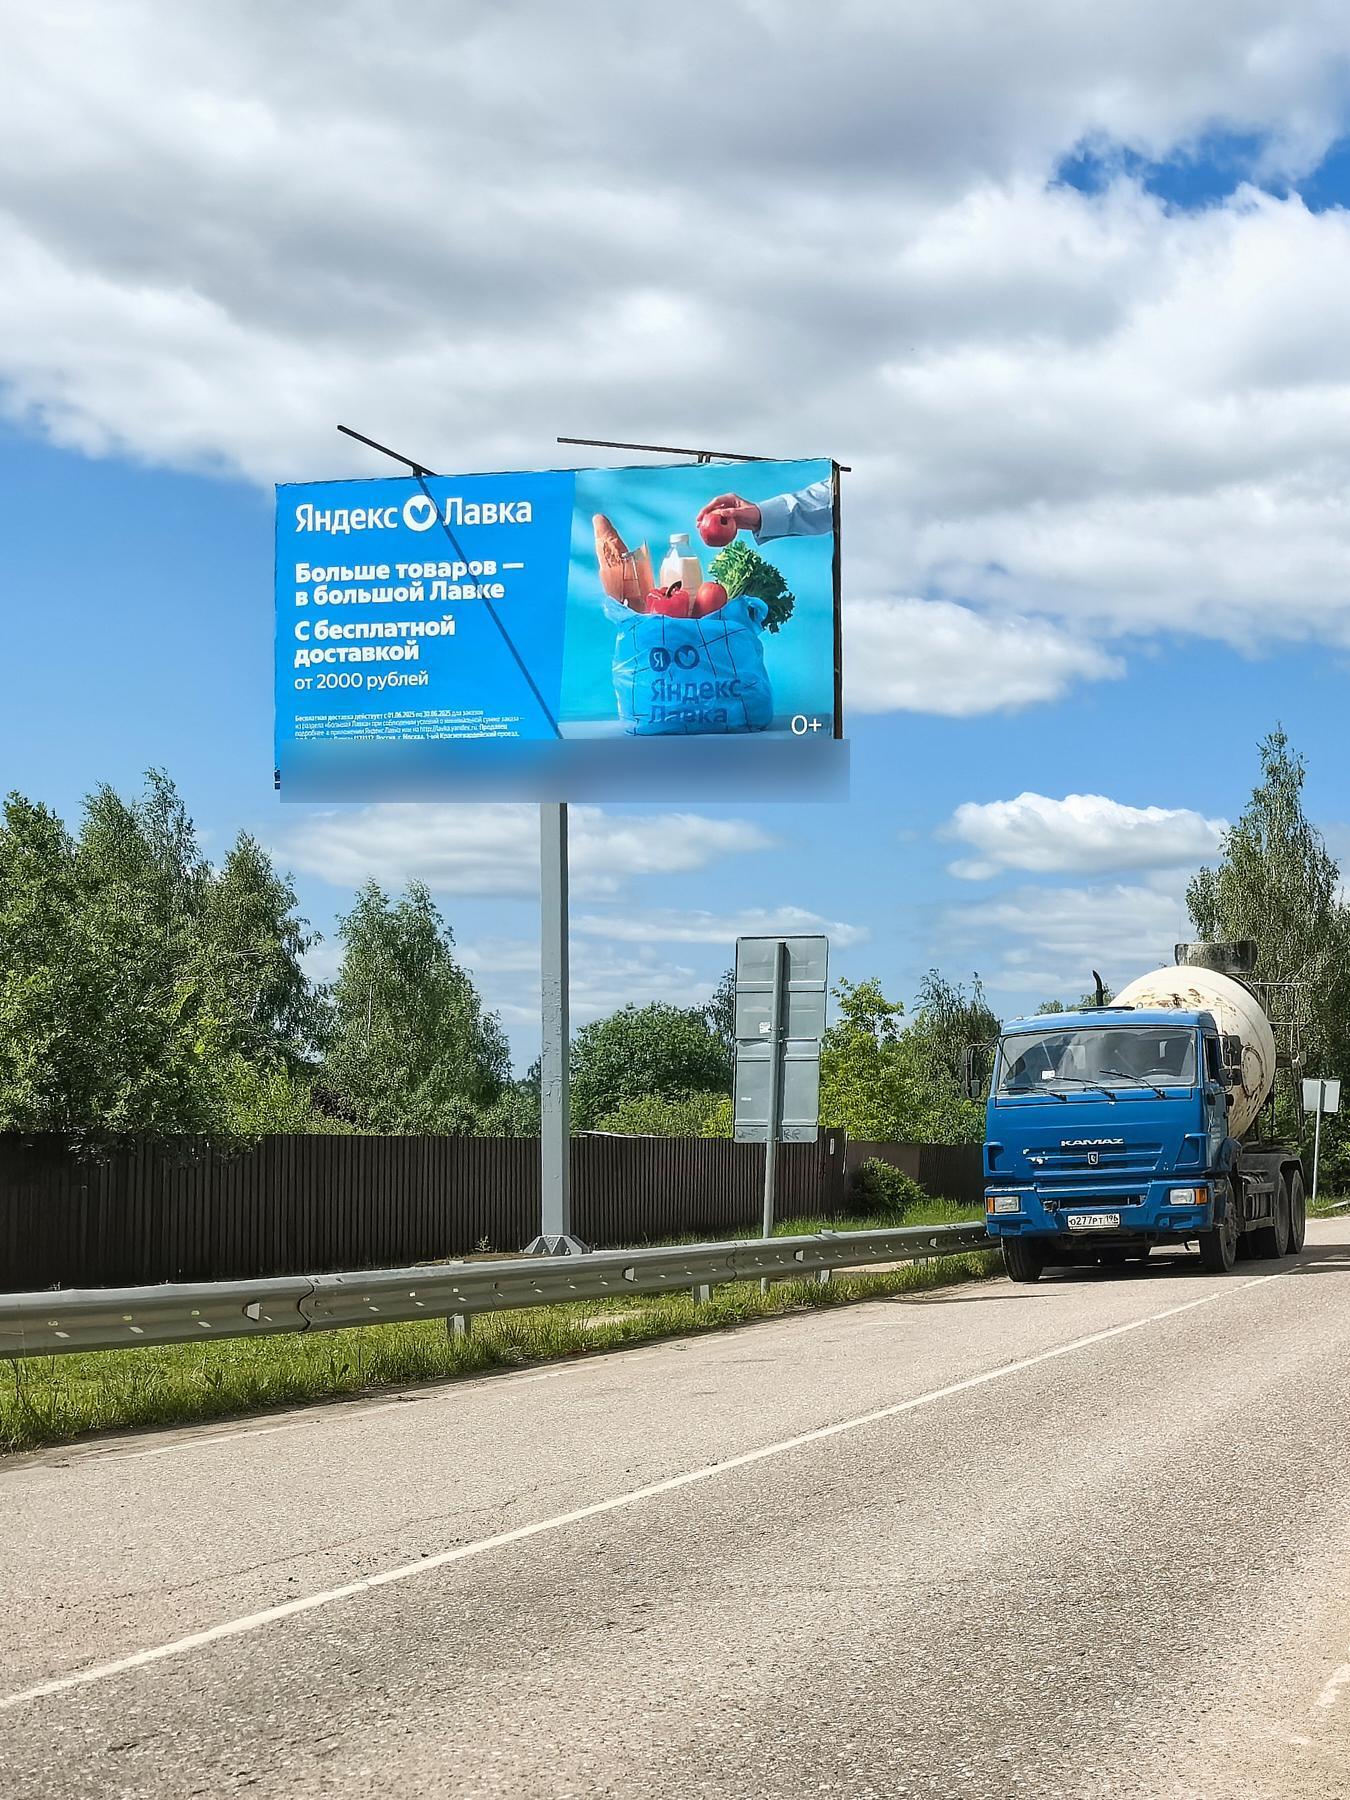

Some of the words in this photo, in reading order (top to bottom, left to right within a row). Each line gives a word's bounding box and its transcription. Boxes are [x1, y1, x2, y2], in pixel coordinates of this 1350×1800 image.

[295, 503, 398, 535] Яндекс
[443, 497, 532, 526] Лавка
[295, 562, 390, 583] Больше
[396, 560, 497, 582] товаров
[295, 590, 309, 606] в
[313, 581, 424, 605] большой
[430, 580, 505, 602] Лавке
[294, 621, 310, 641] С
[314, 615, 456, 640] бесплатной
[294, 640, 419, 668] доставкой
[294, 677, 313, 690] от
[316, 672, 363, 689] 2000
[367, 670, 429, 691] рублей
[650, 679, 741, 705] Яндекс
[791, 715, 822, 736] 0+
[1061, 1138, 1124, 1147] KAMAZ
